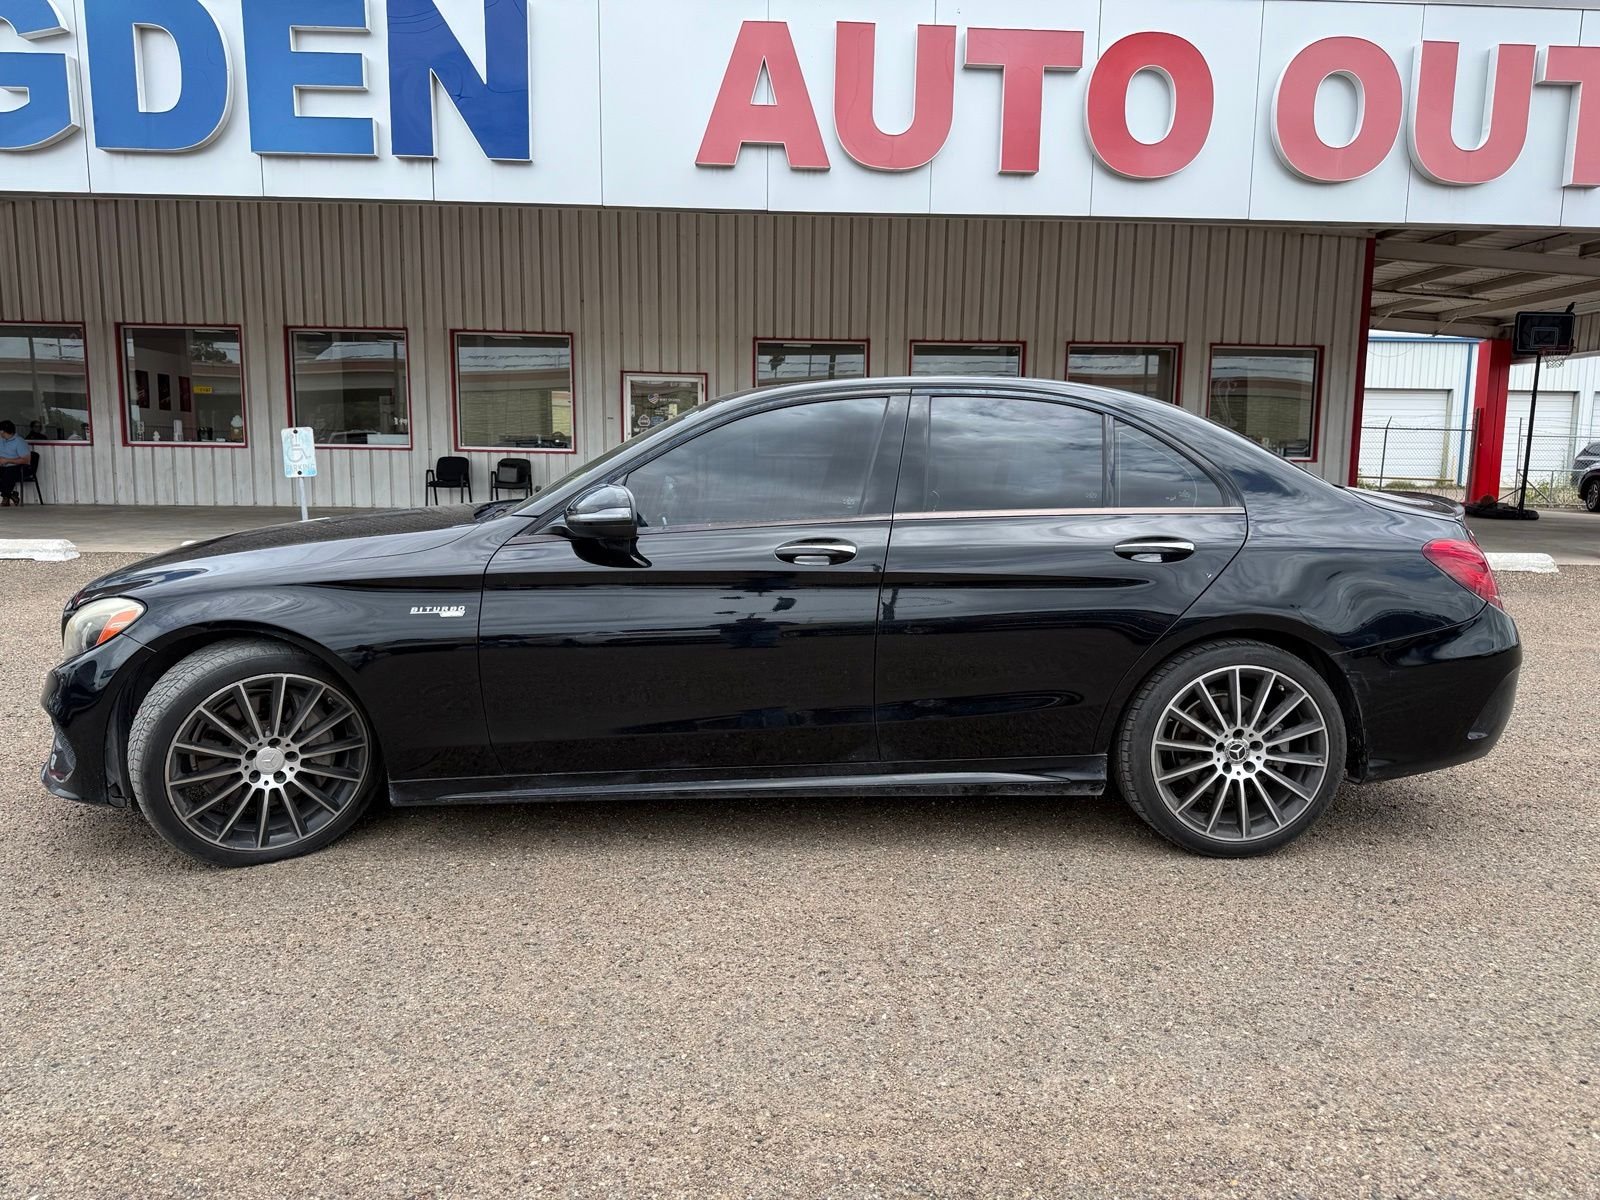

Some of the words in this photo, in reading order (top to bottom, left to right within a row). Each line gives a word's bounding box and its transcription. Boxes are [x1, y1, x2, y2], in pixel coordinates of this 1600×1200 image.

[695, 20, 1215, 181] AUTO
[285, 463, 316, 473] PARKING
[410, 605, 465, 613] BITURBO
